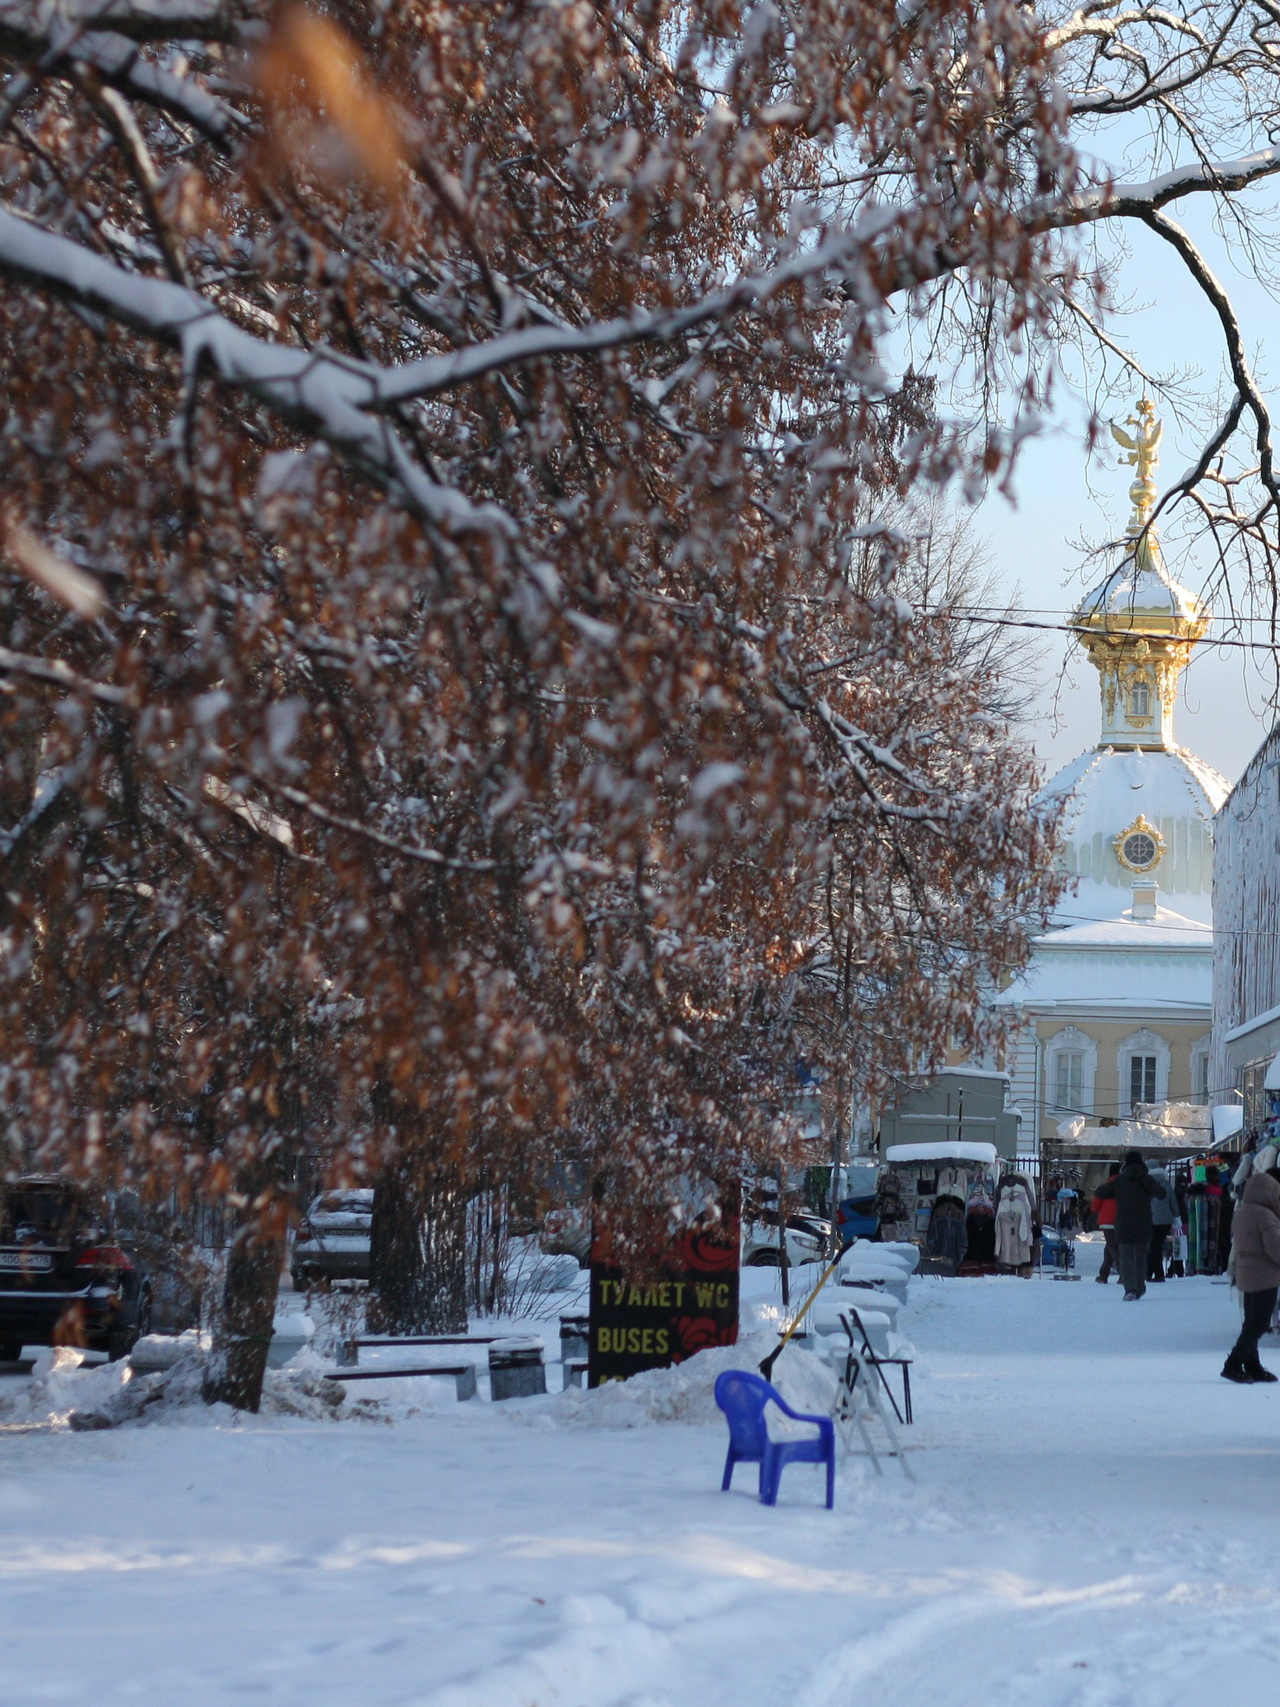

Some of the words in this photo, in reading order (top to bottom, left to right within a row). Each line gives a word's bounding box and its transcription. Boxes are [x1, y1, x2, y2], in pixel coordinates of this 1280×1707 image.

[599, 1280, 685, 1308] ТУАЛЕТ
[695, 1282, 730, 1309] WC
[597, 1327, 669, 1354] BUSES
